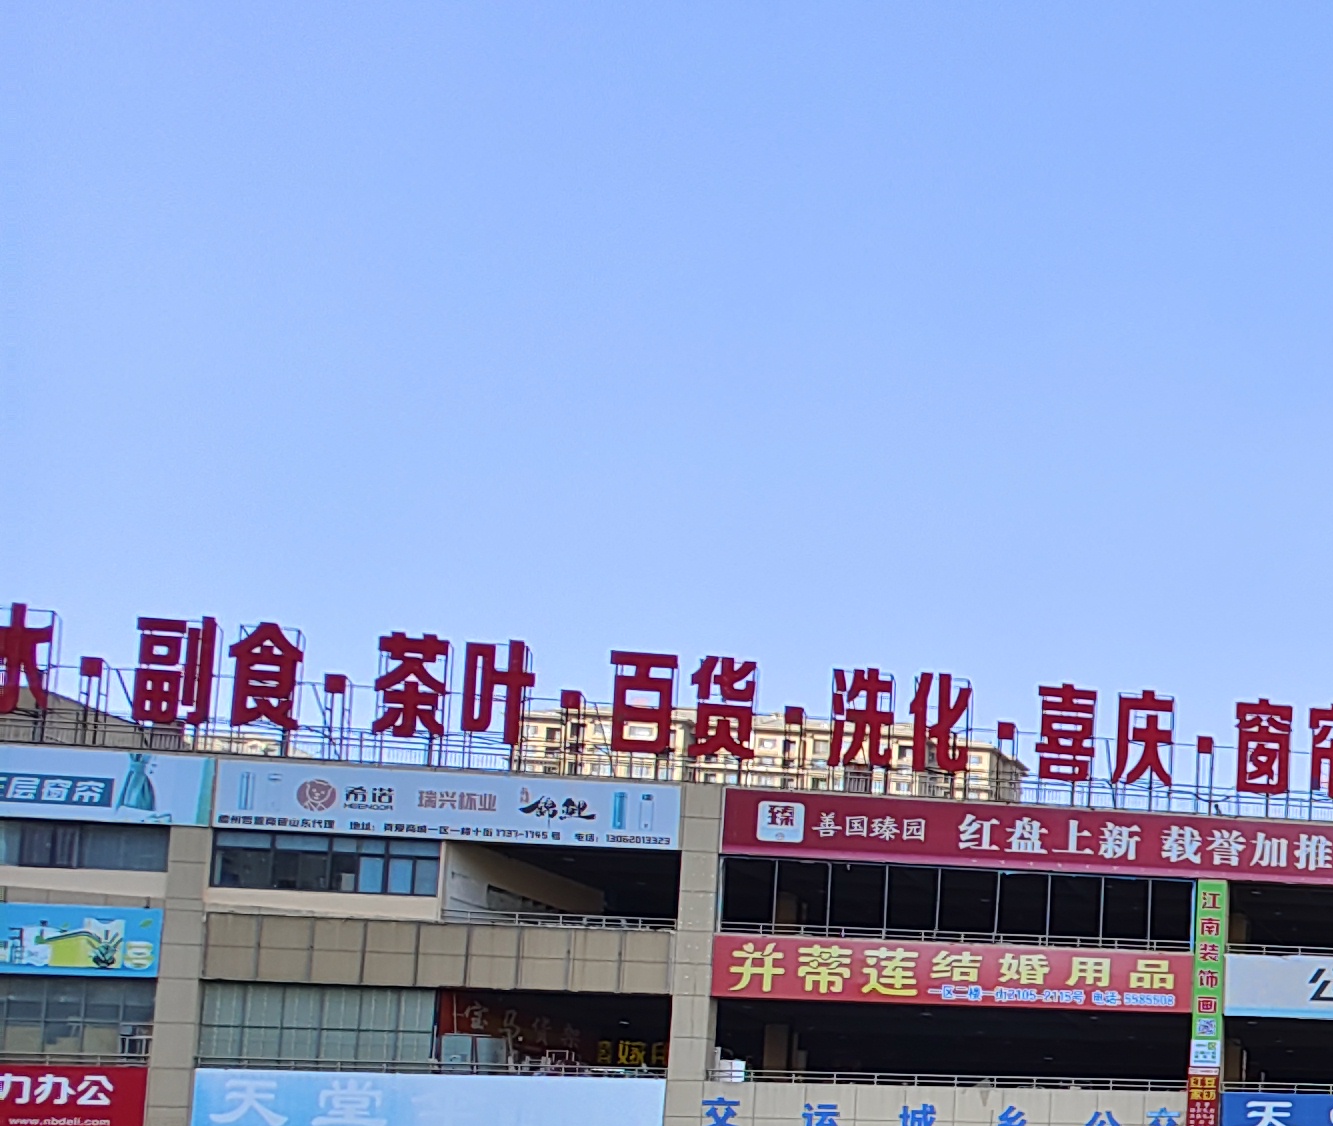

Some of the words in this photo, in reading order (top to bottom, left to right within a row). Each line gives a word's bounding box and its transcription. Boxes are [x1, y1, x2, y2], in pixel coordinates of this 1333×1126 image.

[0, 776, 105, 803] 层窗帘
[345, 786, 394, 804] 希诺
[812, 812, 926, 842] 善国臻园
[958, 813, 1141, 860] 红盘上新
[1160, 825, 1333, 871] 载誉加推
[729, 942, 1175, 997] 并蒂莲结婚用品
[1198, 891, 1222, 1014] 江南装饰画
[0, 1073, 114, 1105] 力办公
